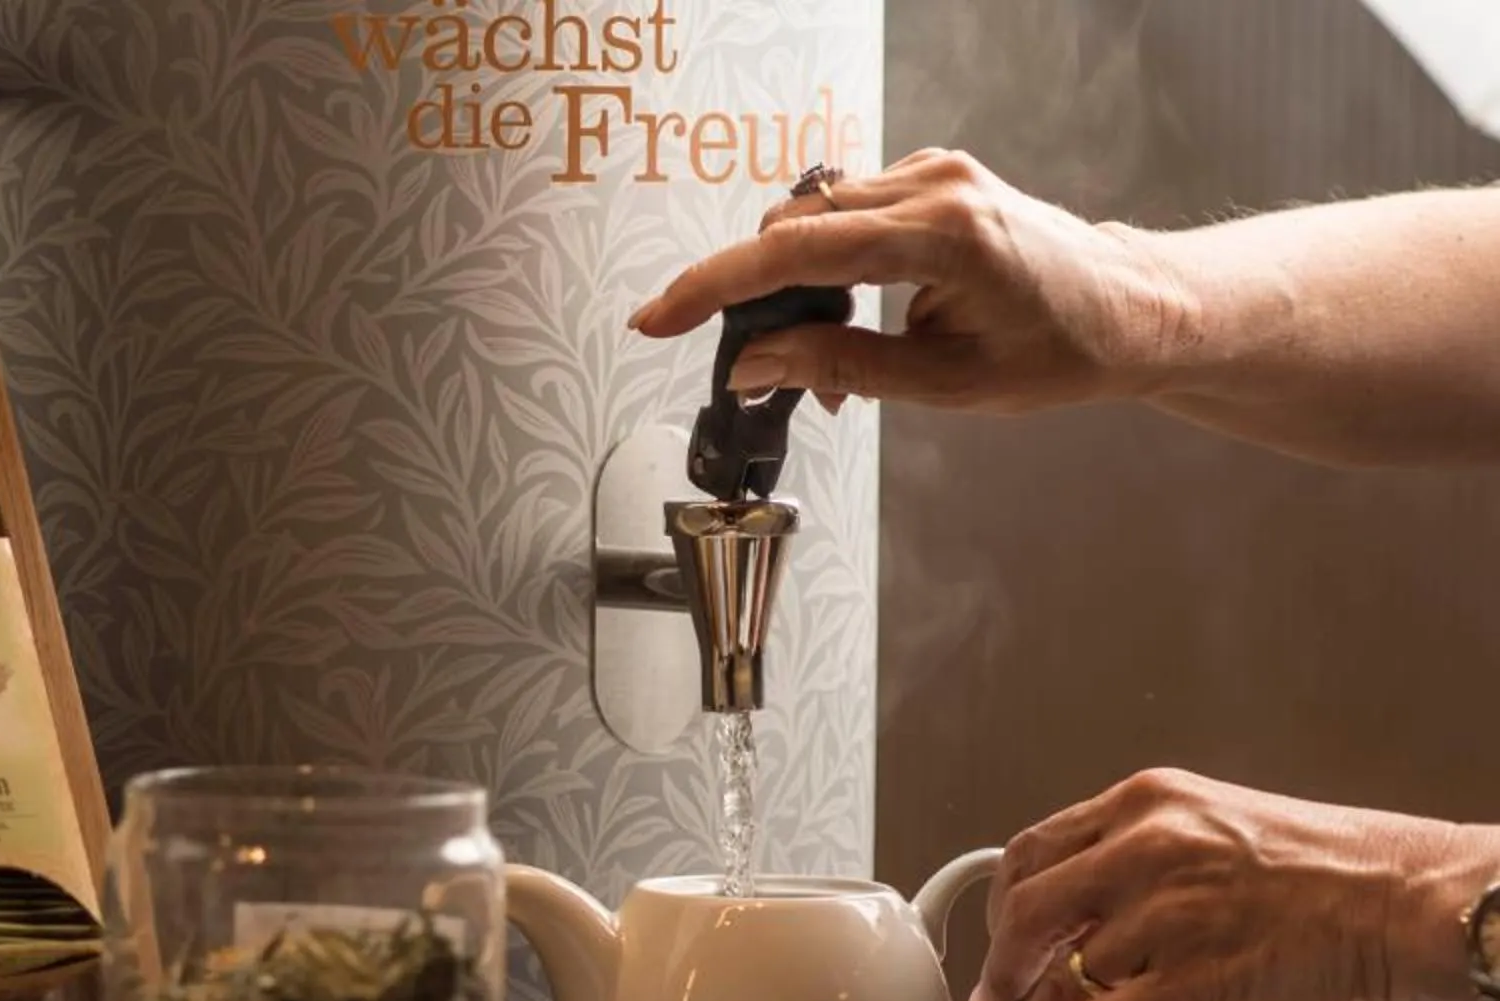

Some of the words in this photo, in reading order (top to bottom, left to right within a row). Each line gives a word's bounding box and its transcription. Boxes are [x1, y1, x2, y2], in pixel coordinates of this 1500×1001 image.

[331, 0, 678, 73] wächst
[407, 83, 533, 150] die
[550, 84, 864, 184] Freude
